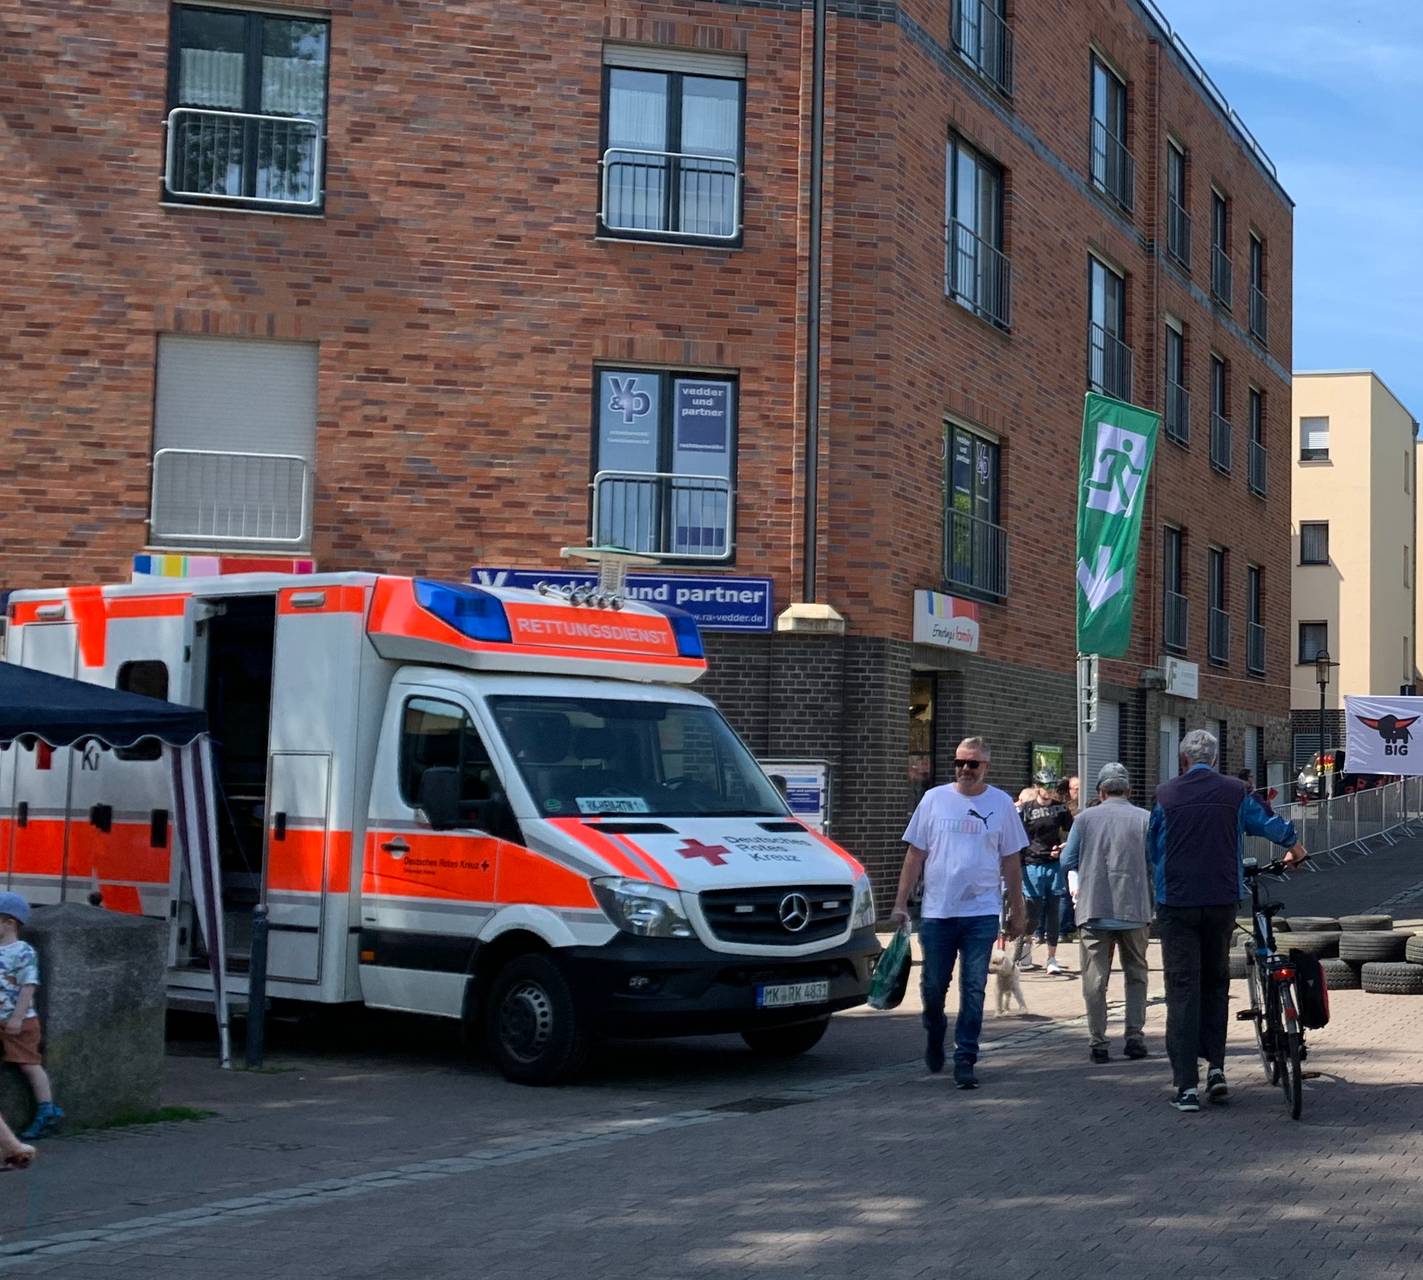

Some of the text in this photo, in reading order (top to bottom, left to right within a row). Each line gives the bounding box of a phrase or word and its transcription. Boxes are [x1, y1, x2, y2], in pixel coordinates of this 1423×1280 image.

[682, 387, 725, 396] vedder
[692, 398, 714, 406] und
[681, 408, 724, 417] partner
[624, 584, 668, 601] und
[675, 587, 764, 605] partner
[516, 617, 669, 645] RETTUNGSDIENST
[1384, 744, 1409, 757] BIG
[723, 836, 812, 846] Deutsches
[737, 844, 788, 852] Rotes
[751, 853, 801, 862] Kreuz
[764, 987, 780, 1003] MK
[788, 985, 802, 1001] RK
